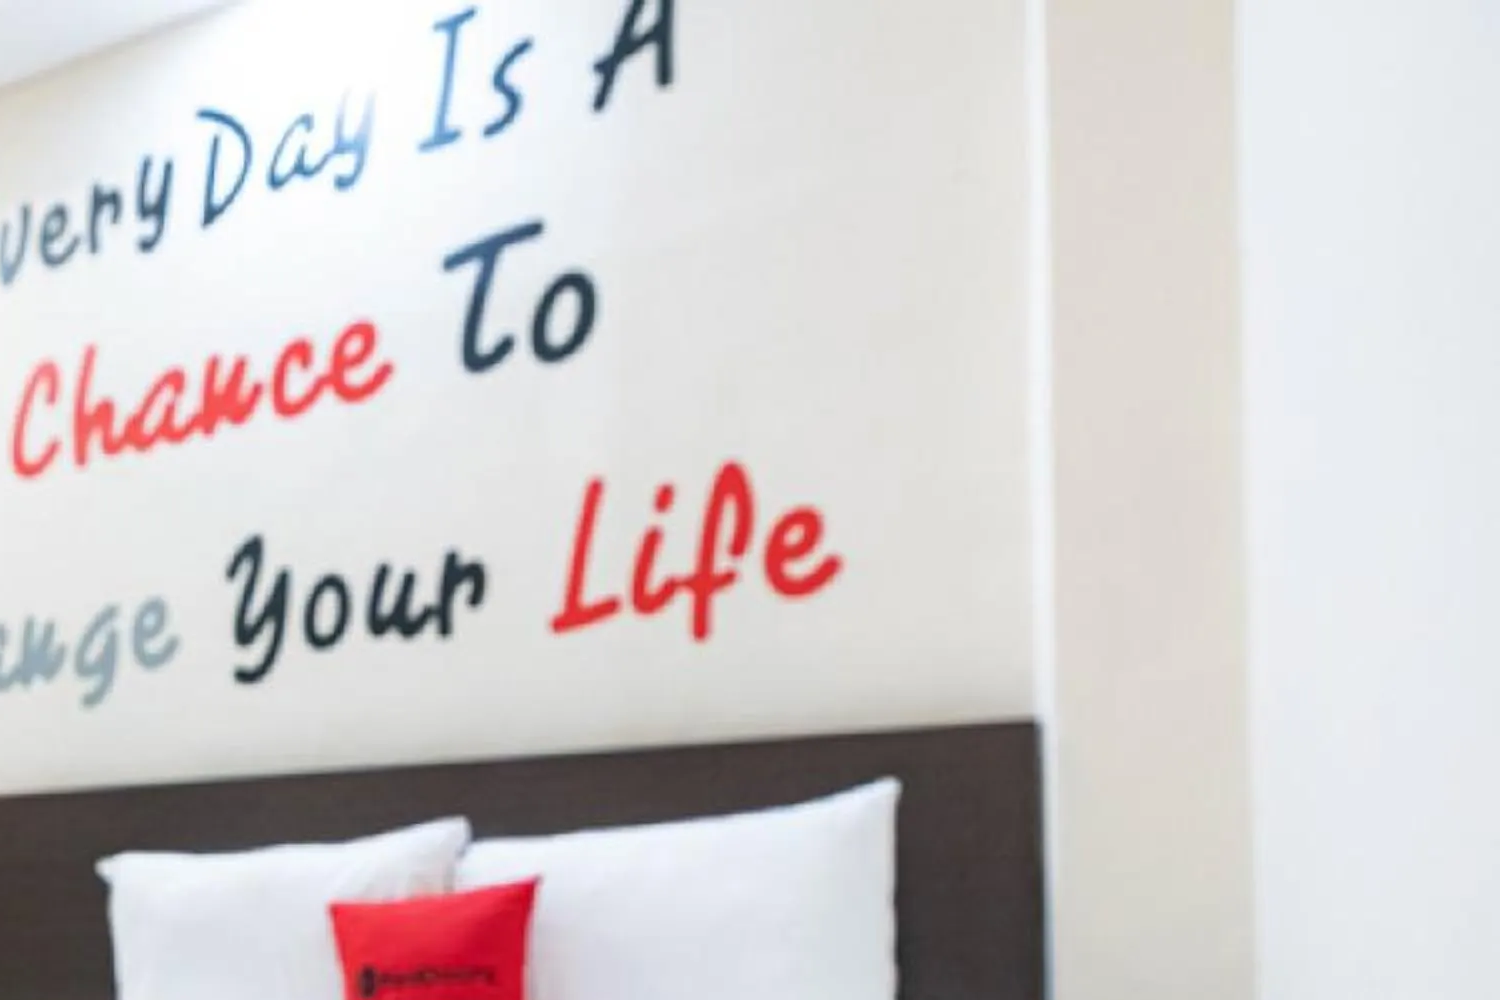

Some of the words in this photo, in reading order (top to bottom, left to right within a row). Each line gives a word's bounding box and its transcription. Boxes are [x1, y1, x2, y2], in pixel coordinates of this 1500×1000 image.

[417, 5, 534, 154] Is
[591, 0, 676, 112] A
[9, 317, 395, 478] Chance
[441, 220, 598, 373] To
[224, 534, 488, 683] Your
[546, 460, 843, 641] Life
